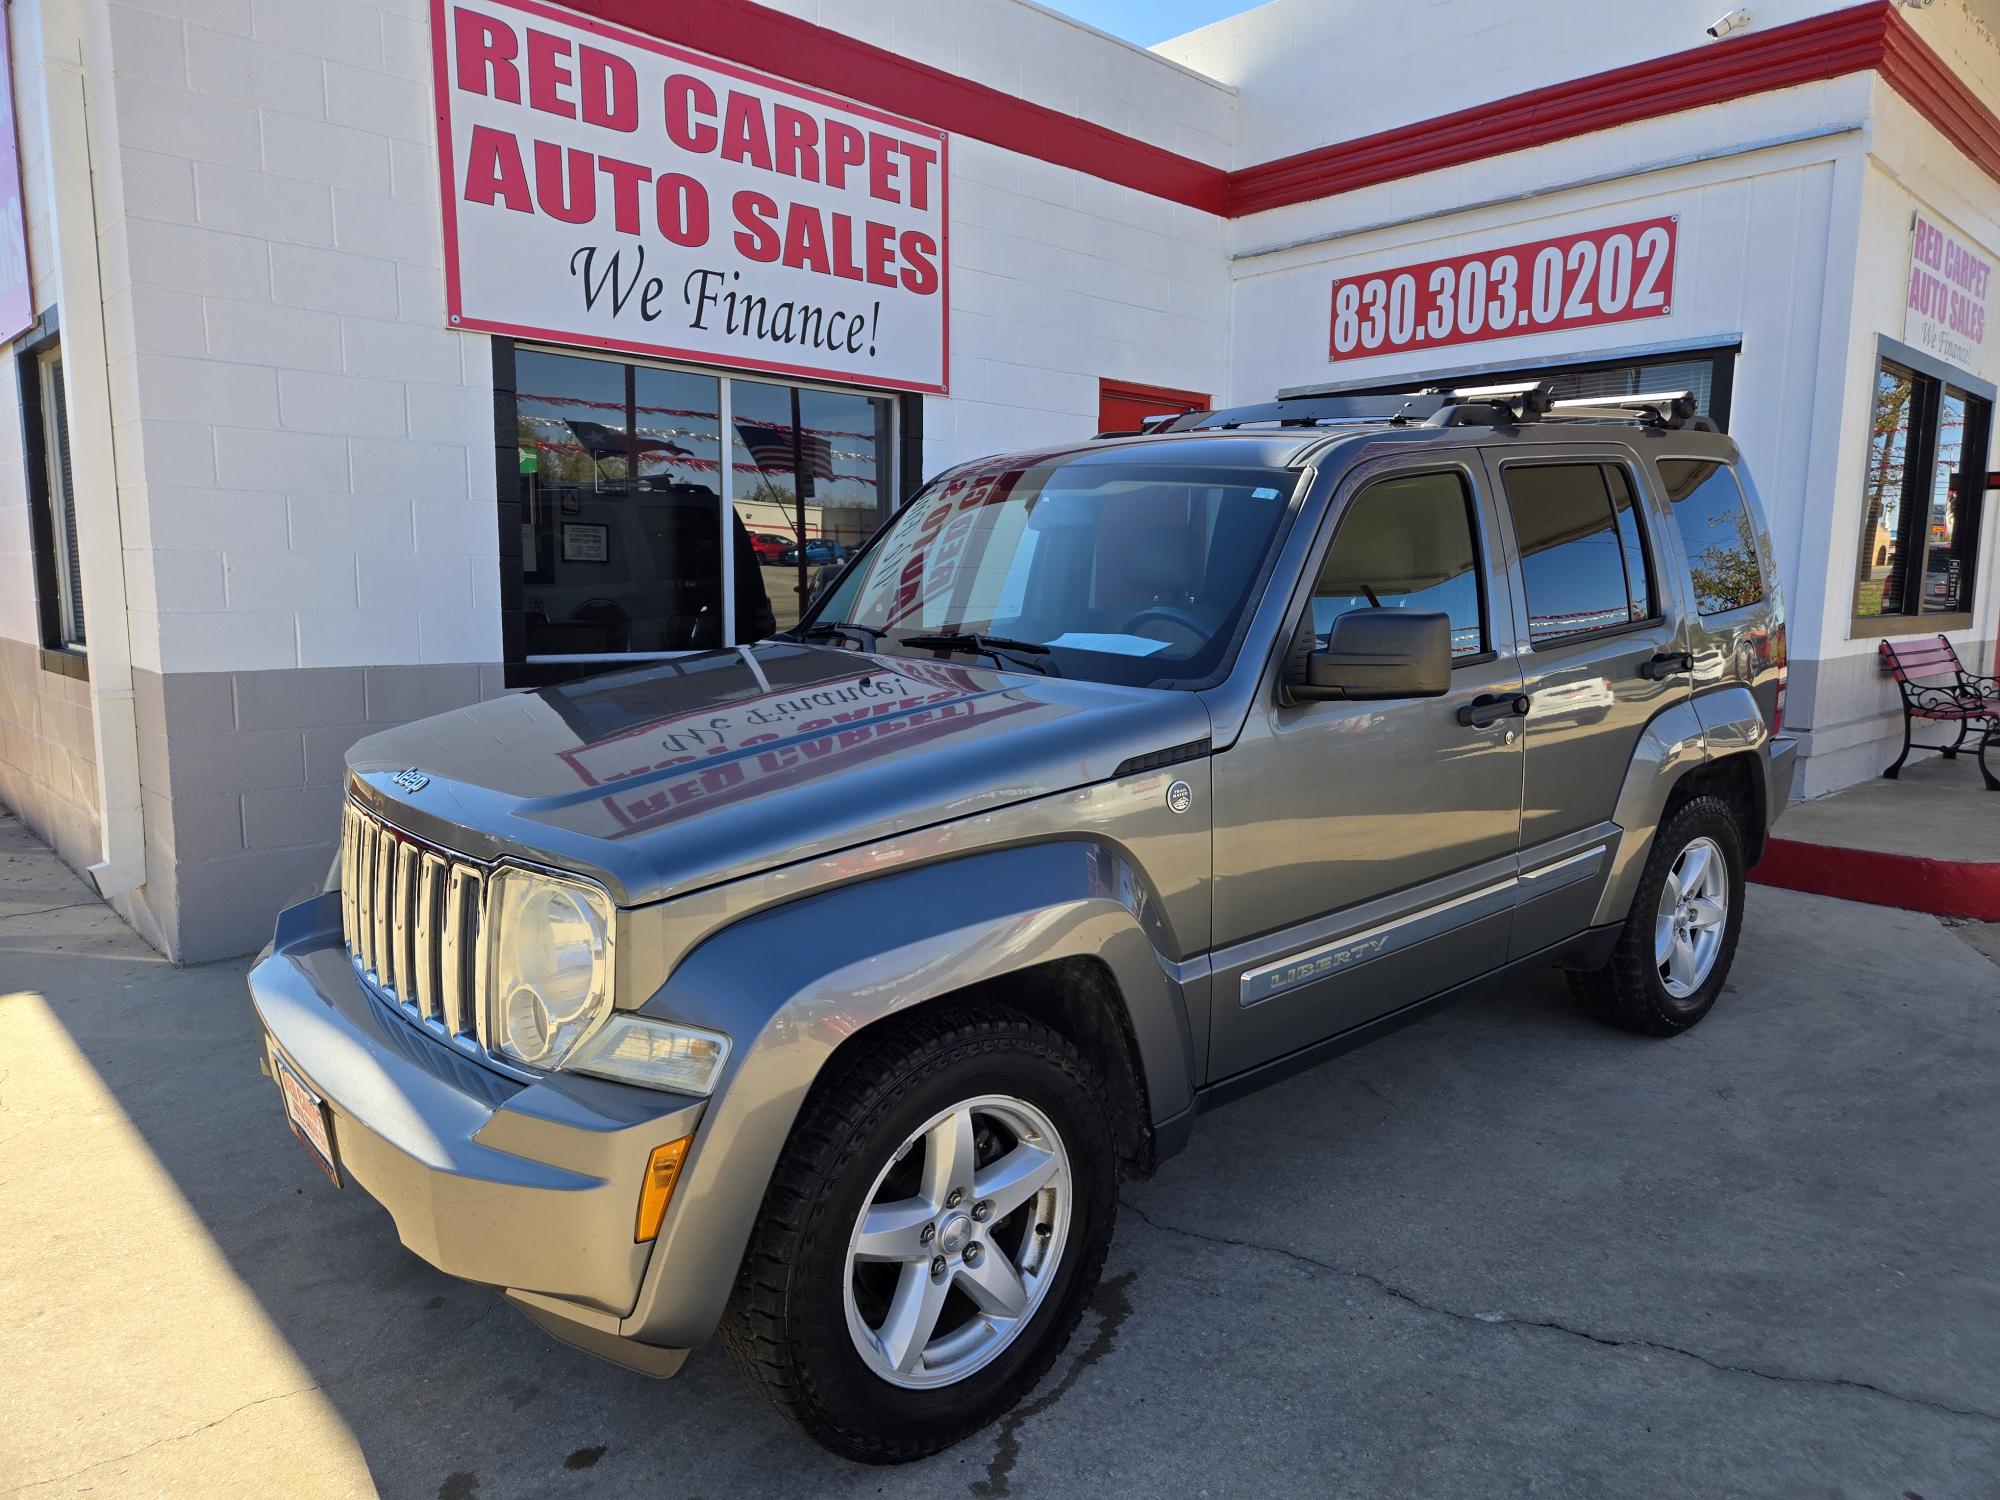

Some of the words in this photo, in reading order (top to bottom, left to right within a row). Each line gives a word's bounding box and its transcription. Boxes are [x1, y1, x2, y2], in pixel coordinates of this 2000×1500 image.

[453, 5, 639, 133] RED
[664, 73, 938, 212] CARPET
[464, 124, 710, 248] AUTO
[732, 190, 939, 296] SALES
[1333, 226, 1671, 353] 830.303.0202
[1914, 217, 1943, 272] RED
[1944, 238, 1991, 301] CARPET
[569, 245, 664, 322] We
[683, 268, 881, 358] Finance!
[1908, 266, 1948, 325] AUTO
[1949, 289, 1985, 345] SALES
[1921, 321, 1937, 350] We
[392, 766, 430, 794] Jeep
[1270, 935, 1389, 989] LIBERTY
